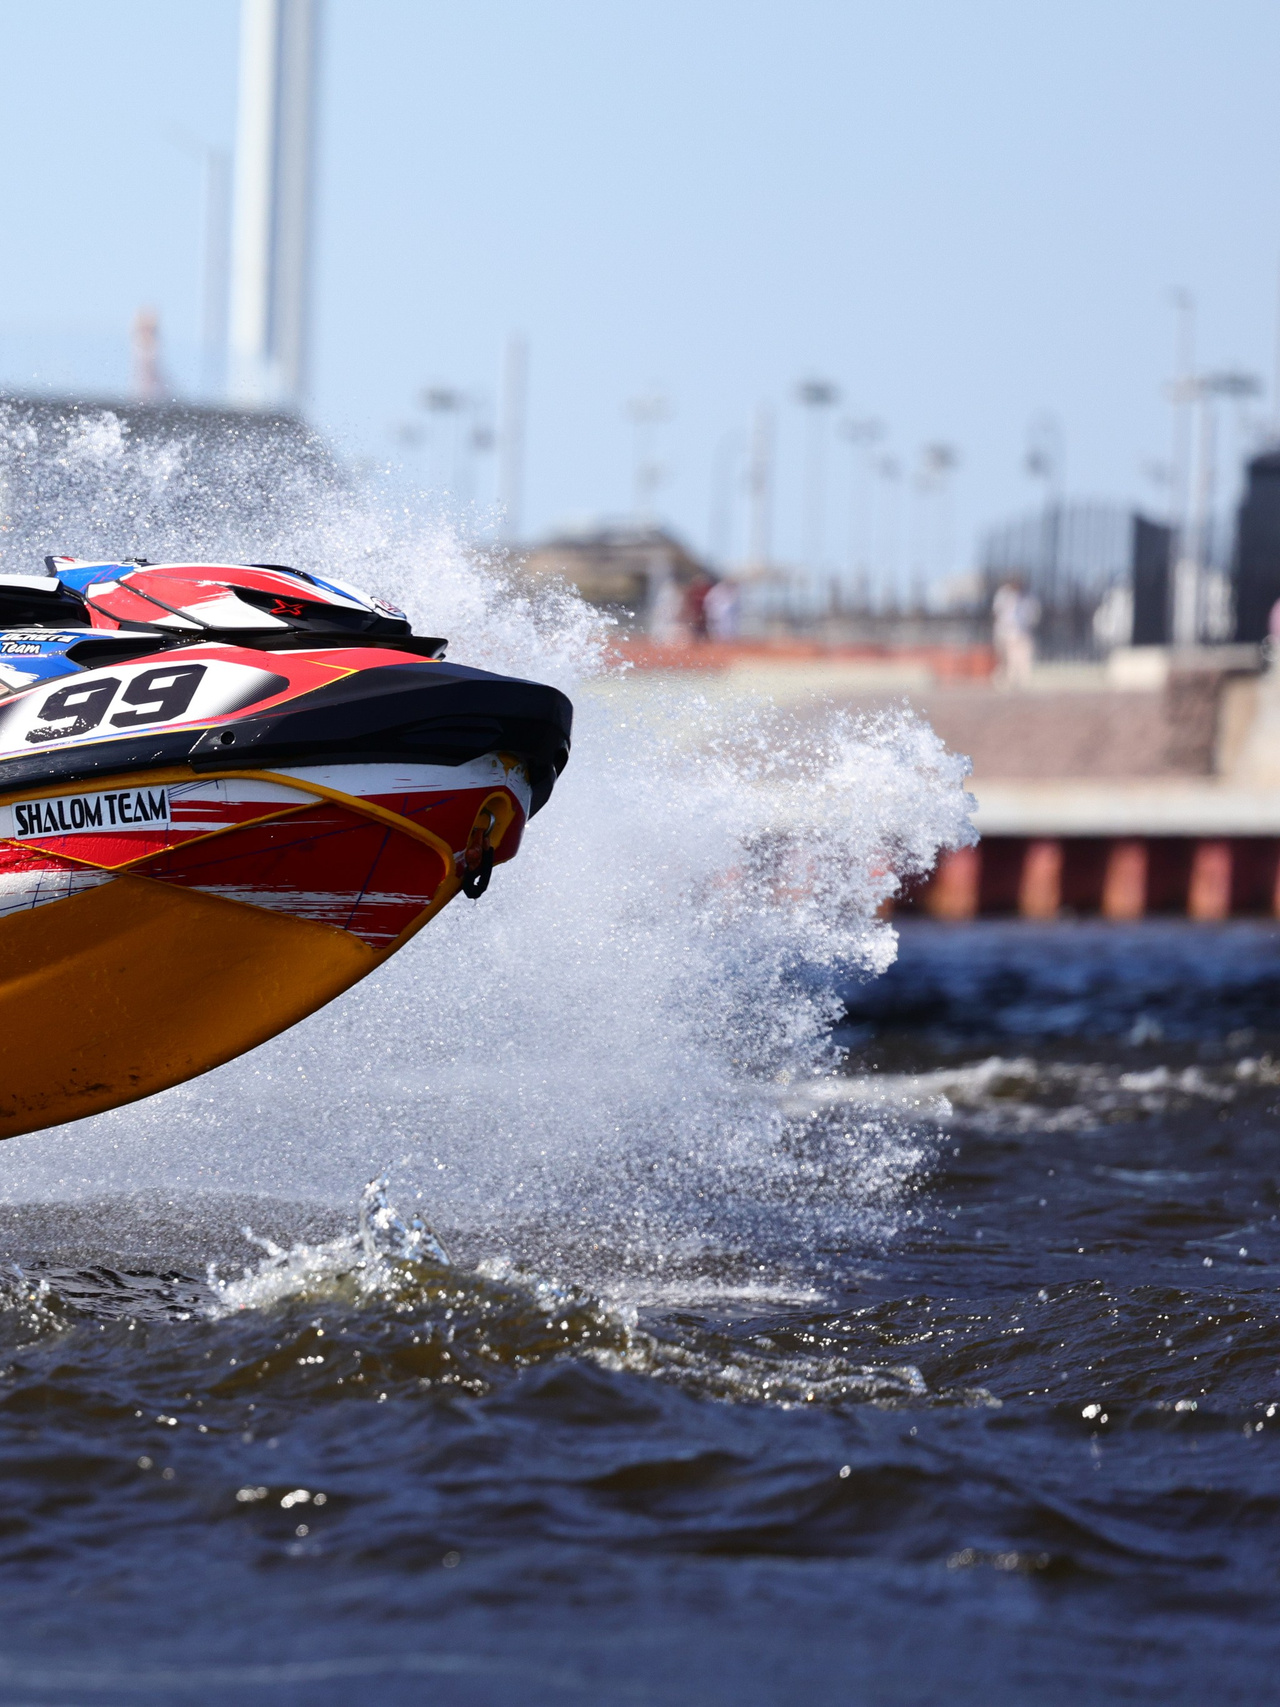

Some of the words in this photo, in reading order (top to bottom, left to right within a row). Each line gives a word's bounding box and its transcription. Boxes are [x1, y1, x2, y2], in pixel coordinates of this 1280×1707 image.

[0, 640, 42, 654] Team
[25, 663, 208, 744] 99
[15, 795, 103, 837] SHALOM
[108, 788, 168, 826] TEAM
